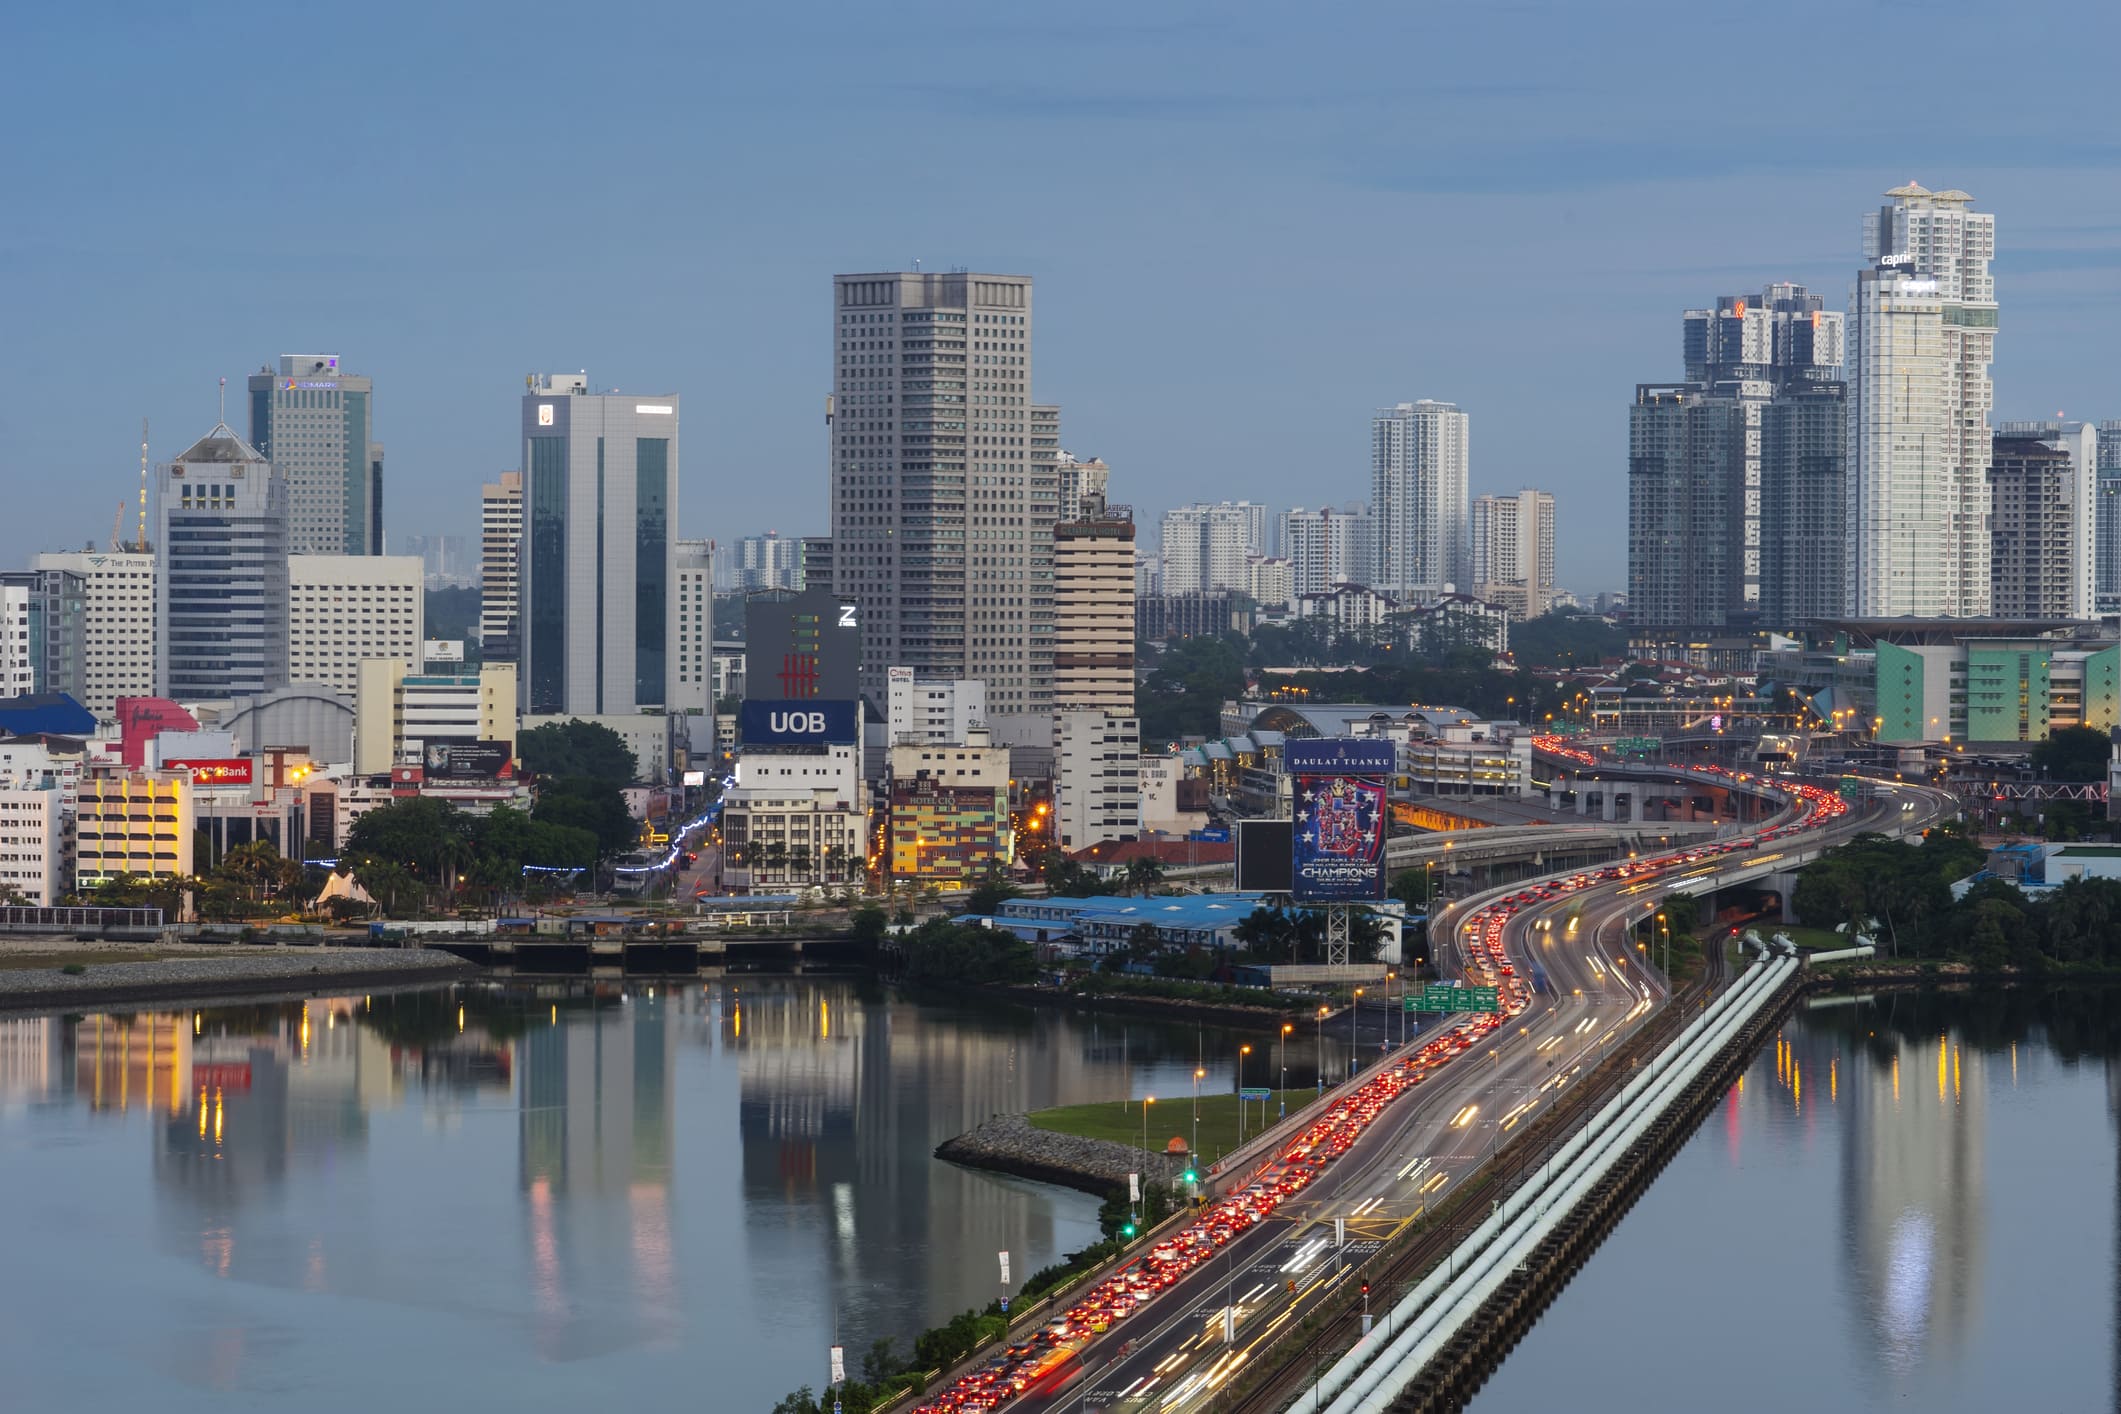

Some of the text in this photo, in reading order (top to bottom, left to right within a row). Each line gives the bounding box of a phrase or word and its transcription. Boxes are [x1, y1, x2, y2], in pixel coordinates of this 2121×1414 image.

[1881, 251, 1907, 267] capri
[770, 711, 826, 734] UOB
[1293, 758, 1389, 766] DAULAT TUANKU
[223, 766, 248, 777] Bank
[910, 797, 936, 805] HOTEL
[1302, 868, 1378, 878] CHAMPIONS
